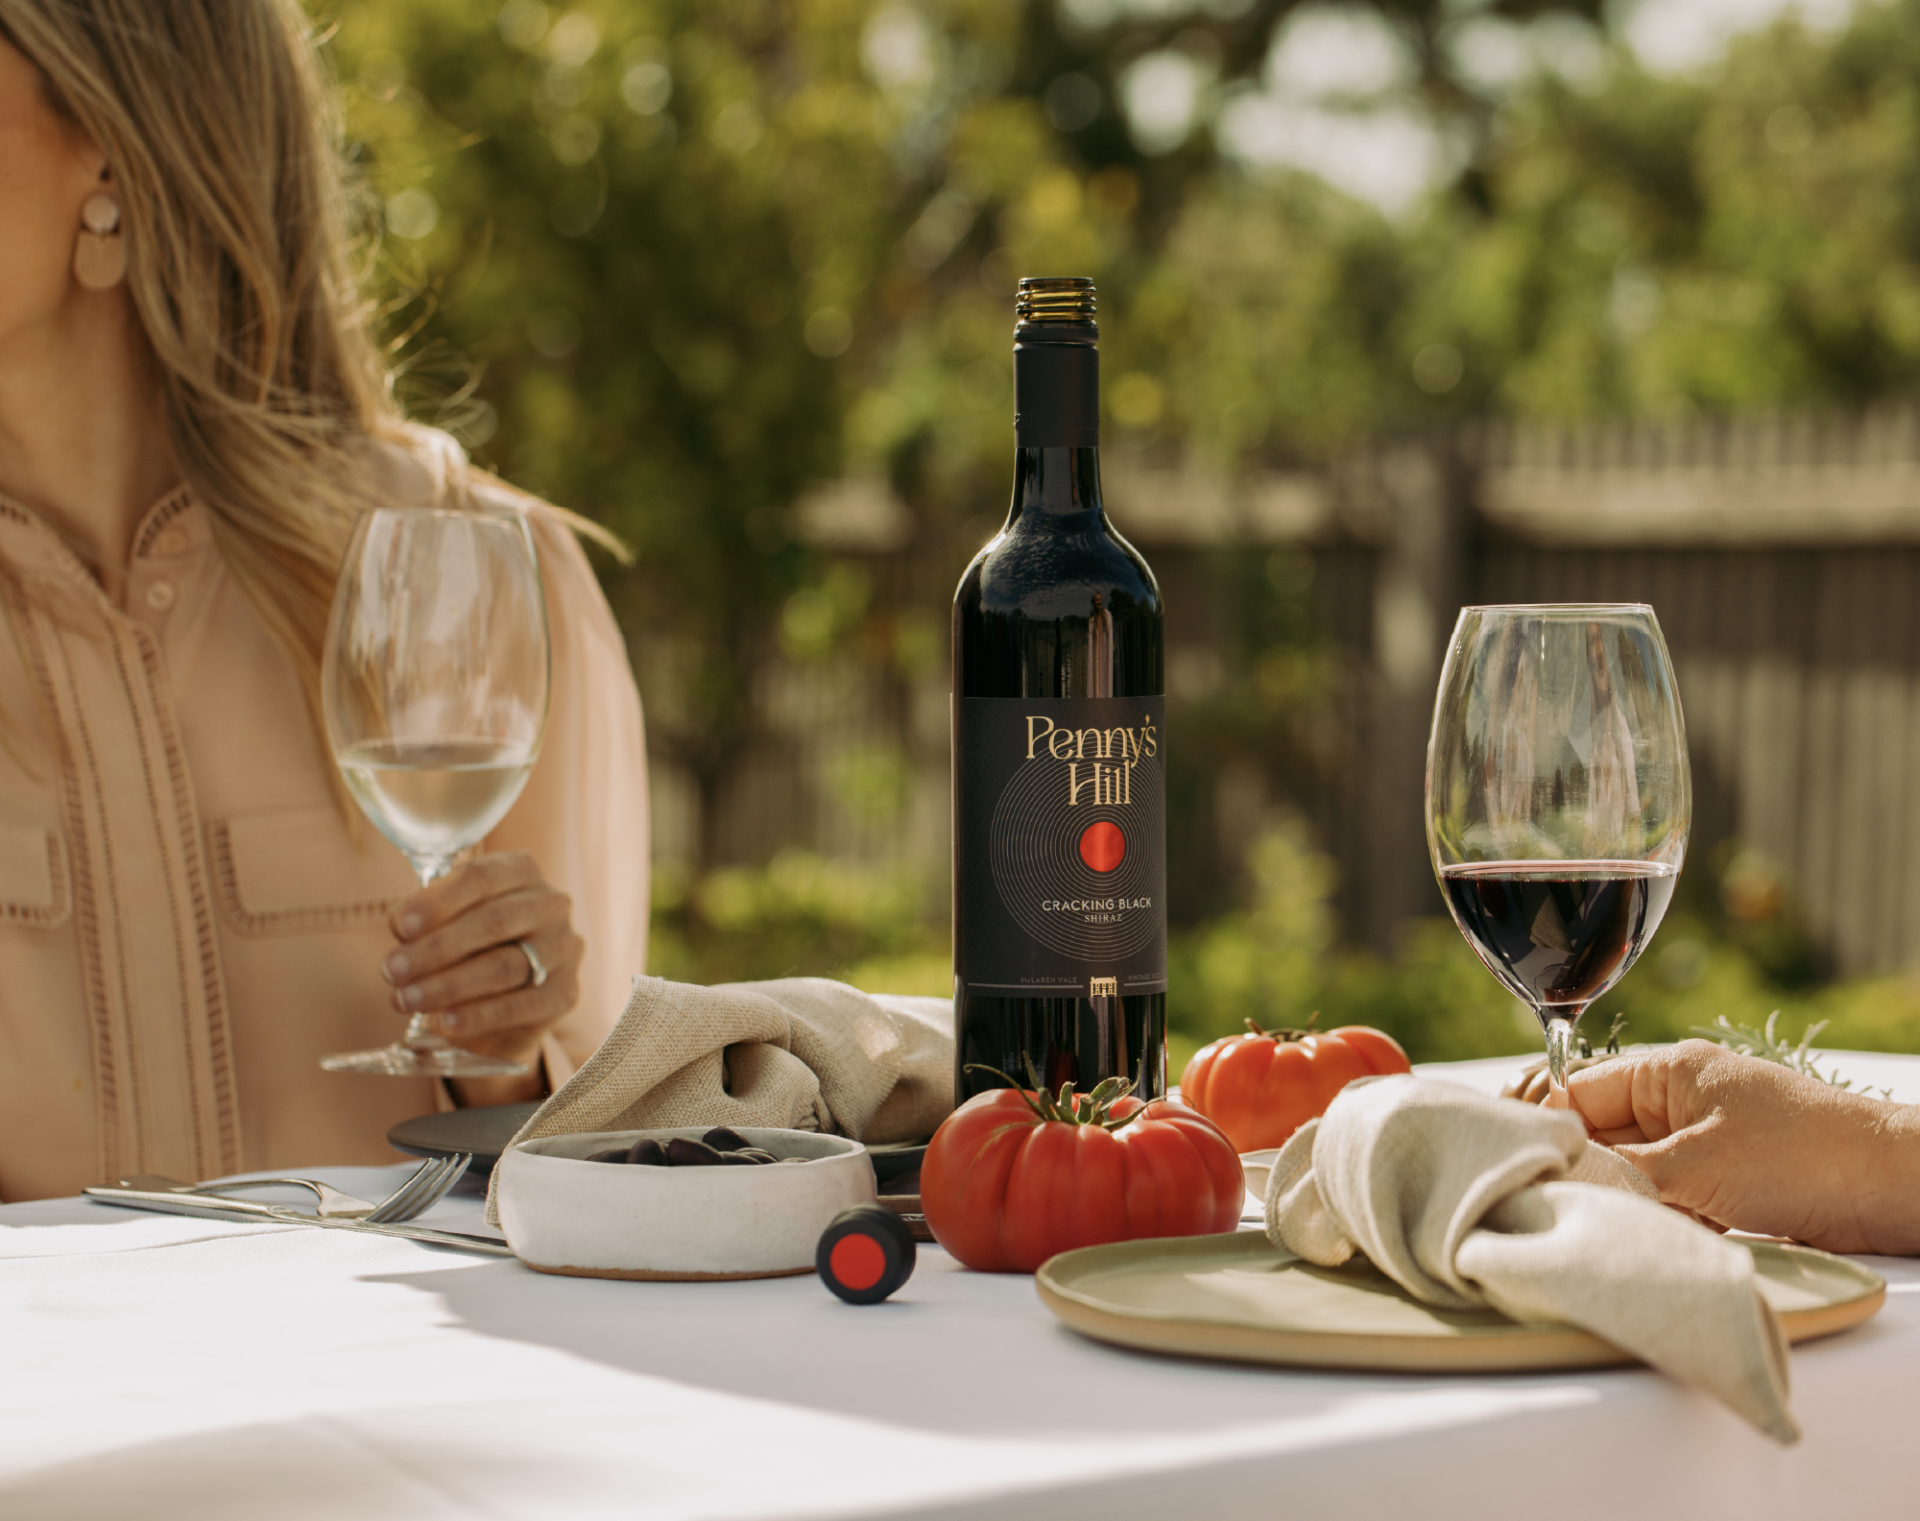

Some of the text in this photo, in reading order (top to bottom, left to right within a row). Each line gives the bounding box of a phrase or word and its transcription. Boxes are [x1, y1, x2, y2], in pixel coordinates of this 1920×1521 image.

[1026, 714, 1157, 768] Penny's
[1068, 759, 1131, 805] Hill
[1042, 897, 1152, 912] CRACKING BLACK
[1084, 914, 1123, 923] SHIRAZ
[1057, 976, 1077, 984] VALE
